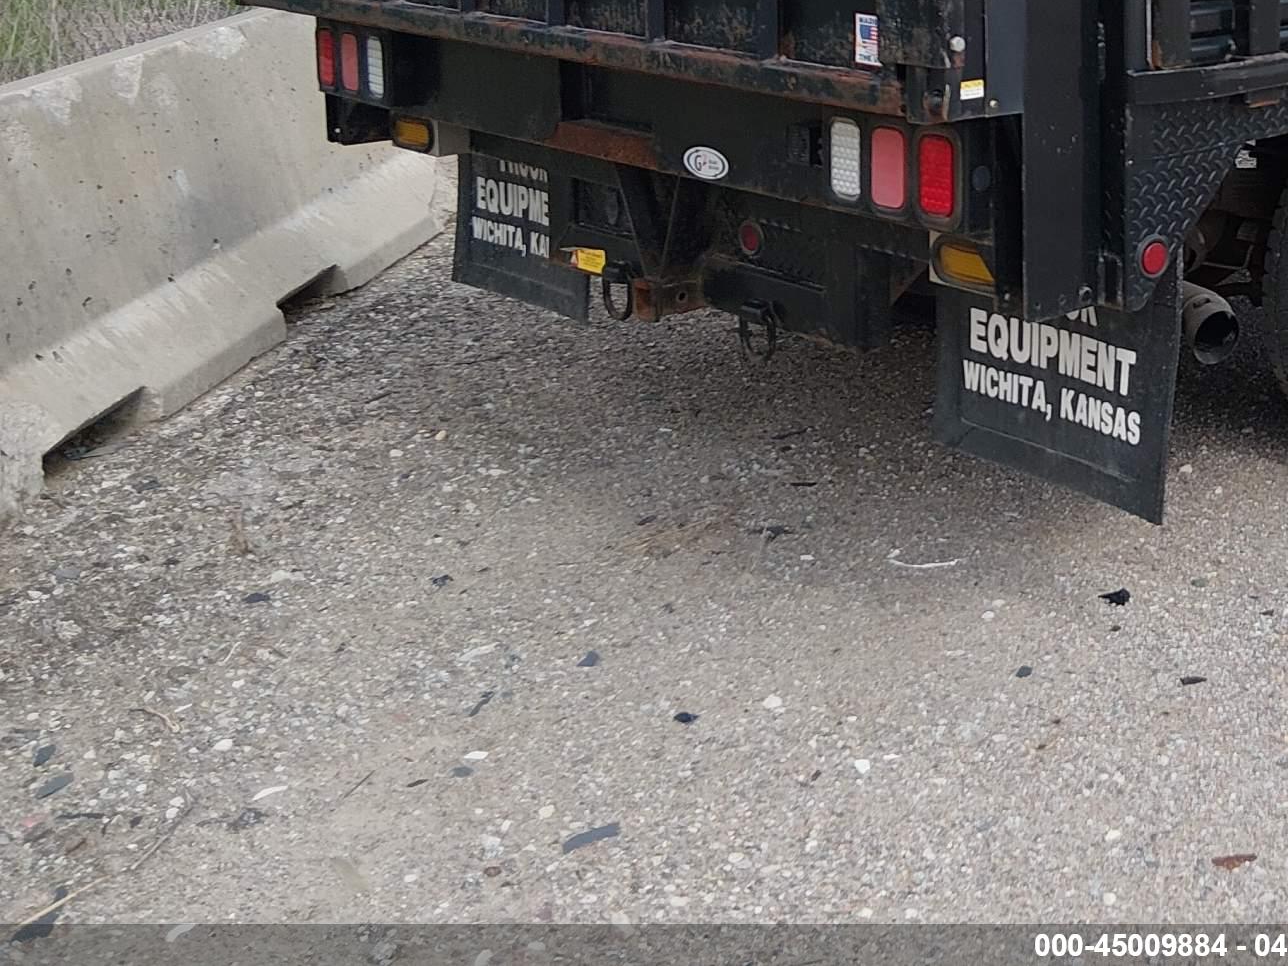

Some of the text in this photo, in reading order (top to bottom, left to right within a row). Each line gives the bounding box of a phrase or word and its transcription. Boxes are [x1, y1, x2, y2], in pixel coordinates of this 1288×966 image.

[471, 216, 527, 257] WICHITA,
[969, 307, 1137, 397] EQUIPMENT
[963, 359, 1053, 421] WICHITA,
[1060, 388, 1141, 445] KANSAS
